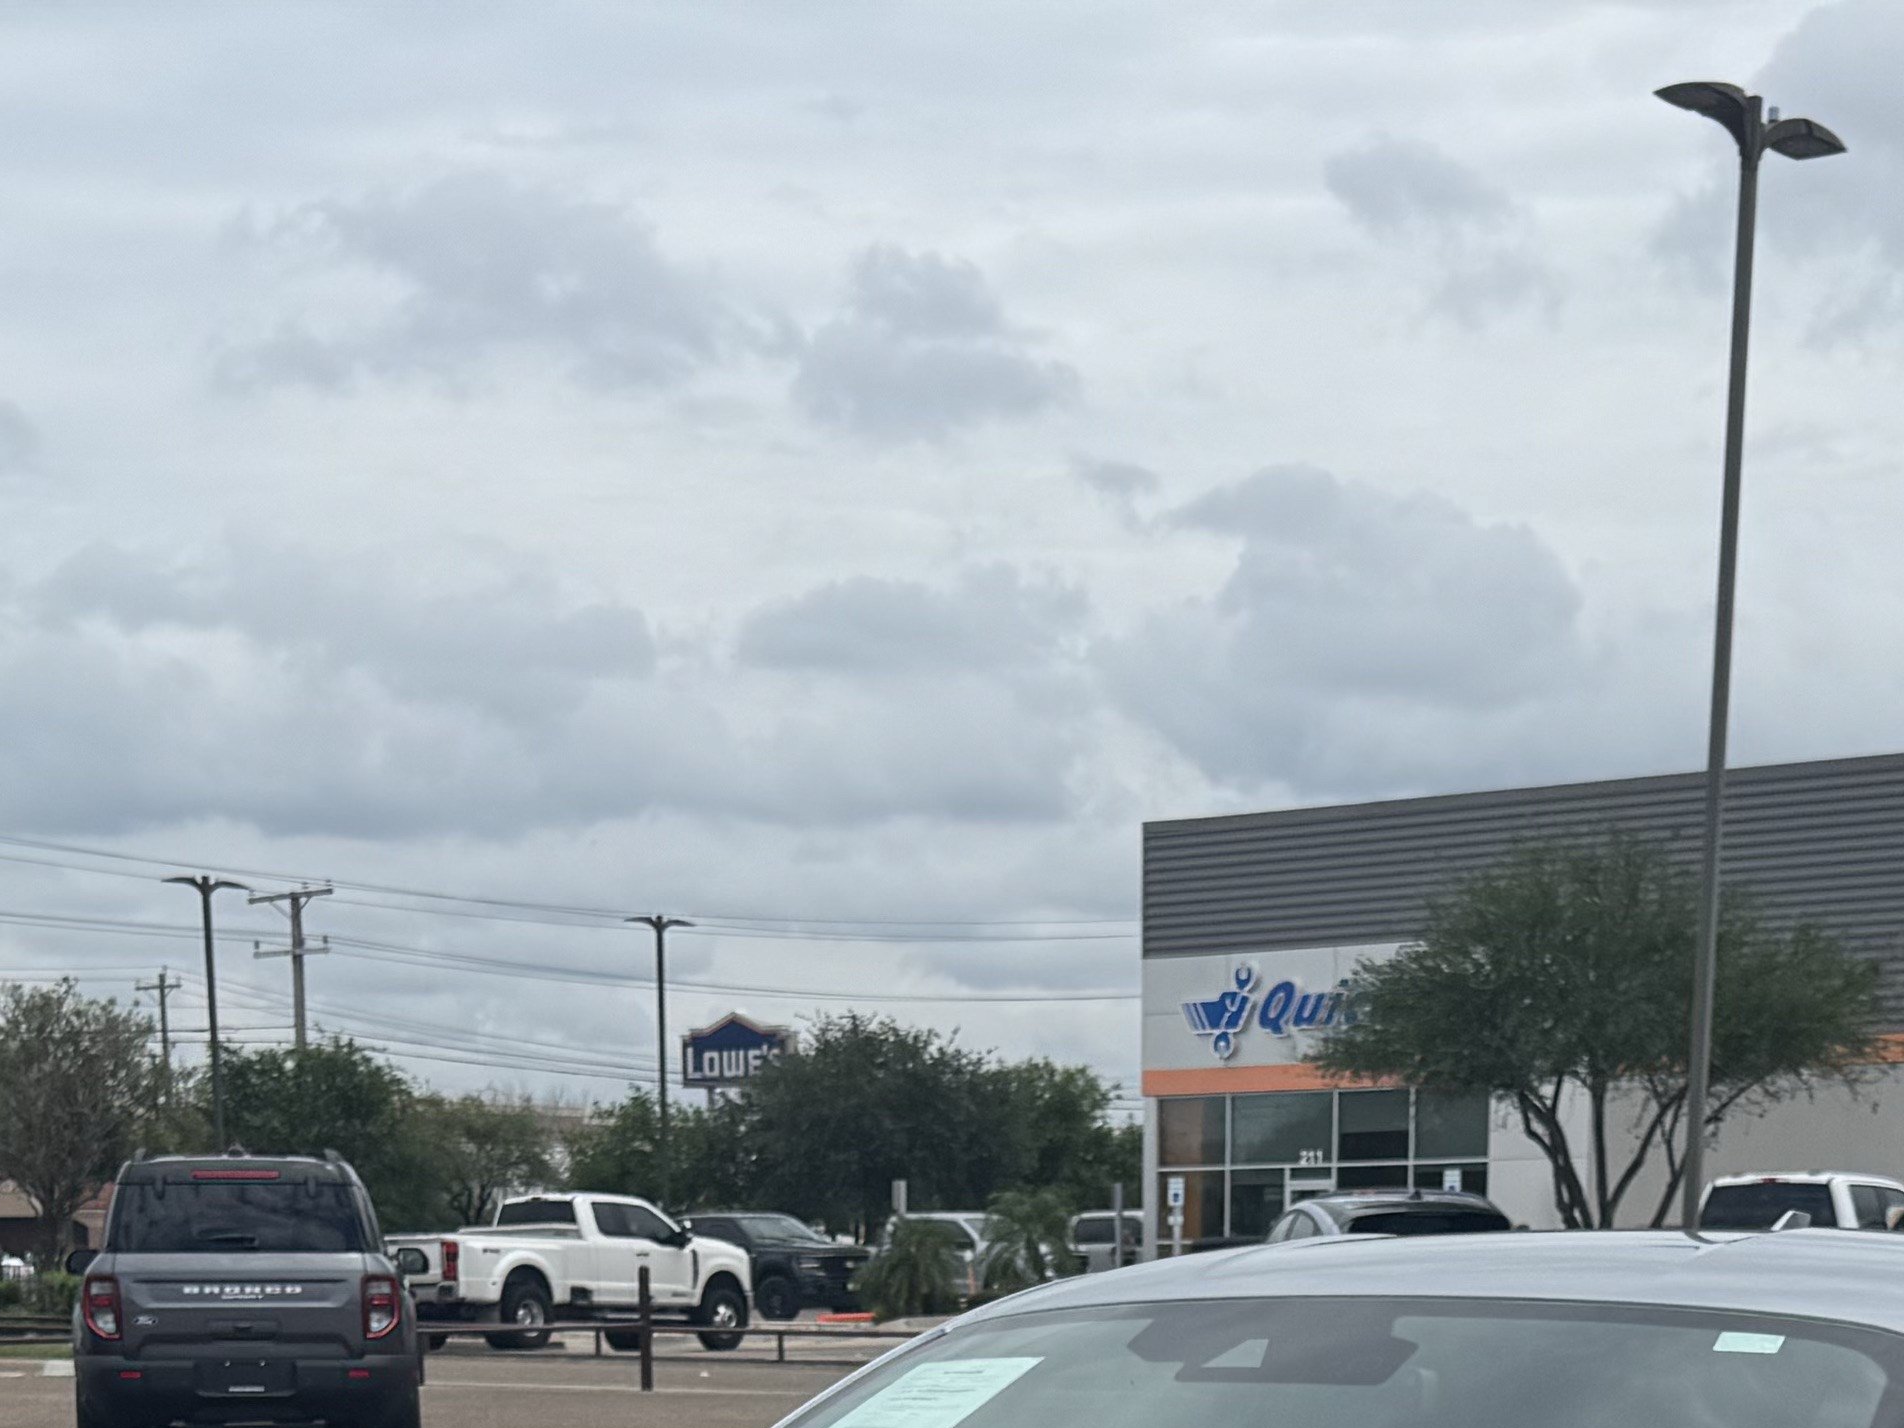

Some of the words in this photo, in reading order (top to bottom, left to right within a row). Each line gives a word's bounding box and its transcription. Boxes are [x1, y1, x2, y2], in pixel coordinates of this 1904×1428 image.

[1259, 979, 1359, 1035] Qui
[1299, 1149, 1324, 1166] 211
[183, 1285, 302, 1294] BRONCO
